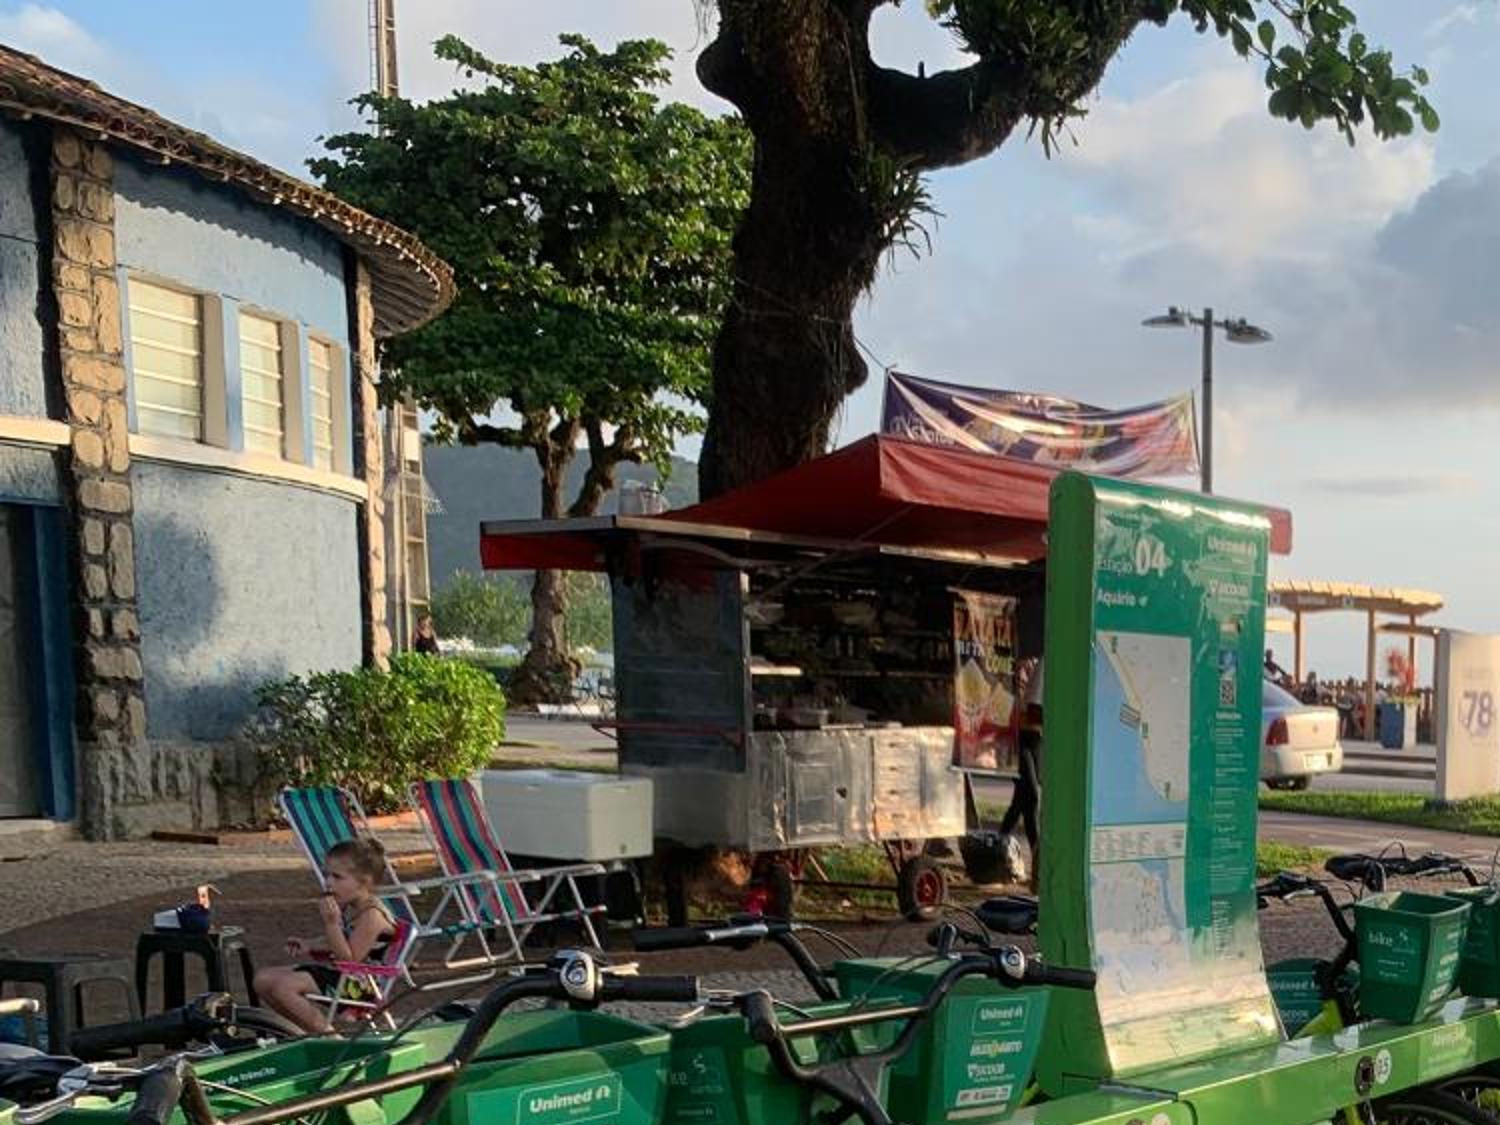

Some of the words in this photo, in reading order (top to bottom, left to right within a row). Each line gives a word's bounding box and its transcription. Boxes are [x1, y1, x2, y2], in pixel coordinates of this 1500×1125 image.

[1135, 537, 1169, 577] 04
[1462, 690, 1493, 730] 78
[530, 1087, 593, 1114] Unimed
